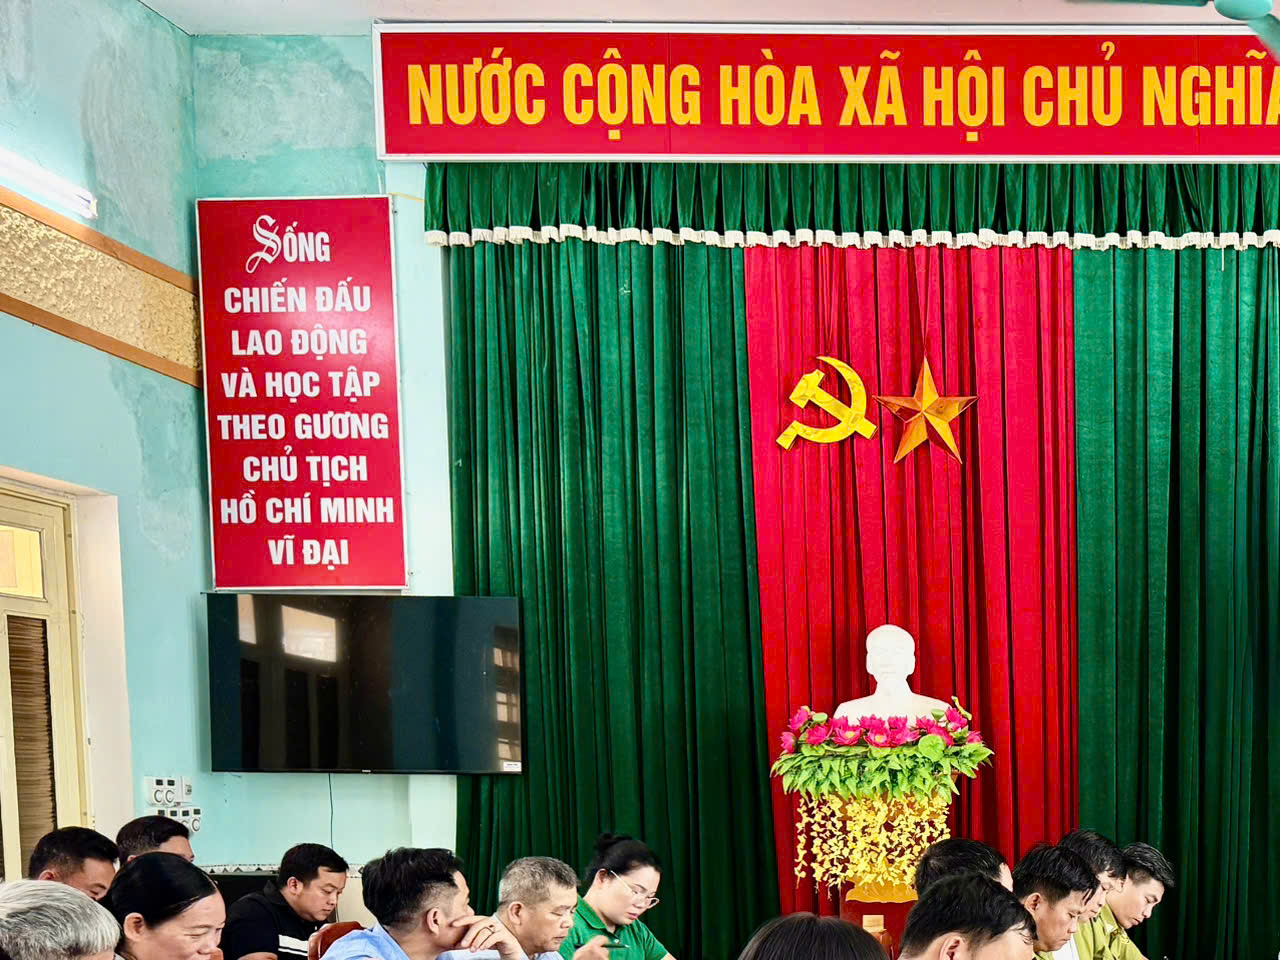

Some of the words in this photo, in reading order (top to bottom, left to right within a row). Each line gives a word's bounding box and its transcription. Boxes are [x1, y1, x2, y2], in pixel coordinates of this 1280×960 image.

[408, 48, 545, 124] NƯỚC
[564, 48, 700, 139] CỘNG
[720, 49, 821, 125] HÒA
[840, 51, 907, 125] XÃ
[924, 50, 1004, 141] HỘI
[1024, 42, 1122, 126] CHỦ
[224, 278, 306, 313] CHIẾN
[315, 277, 371, 312] ĐẤU
[231, 329, 282, 356] LAO
[290, 324, 367, 361] ĐỘNG
[221, 368, 257, 398] VÀ
[265, 371, 321, 403] HỌC
[328, 365, 381, 403] TẬP
[217, 414, 285, 439] THEO
[295, 411, 388, 439] GƯƠNG
[244, 445, 297, 481] CHỦ
[306, 456, 367, 487] TỊCH
[221, 490, 256, 523] HỒ
[266, 492, 311, 523] CHÍ
[320, 497, 394, 523] MINH
[268, 535, 295, 565] VĨ
[302, 539, 349, 570] ĐẠI
